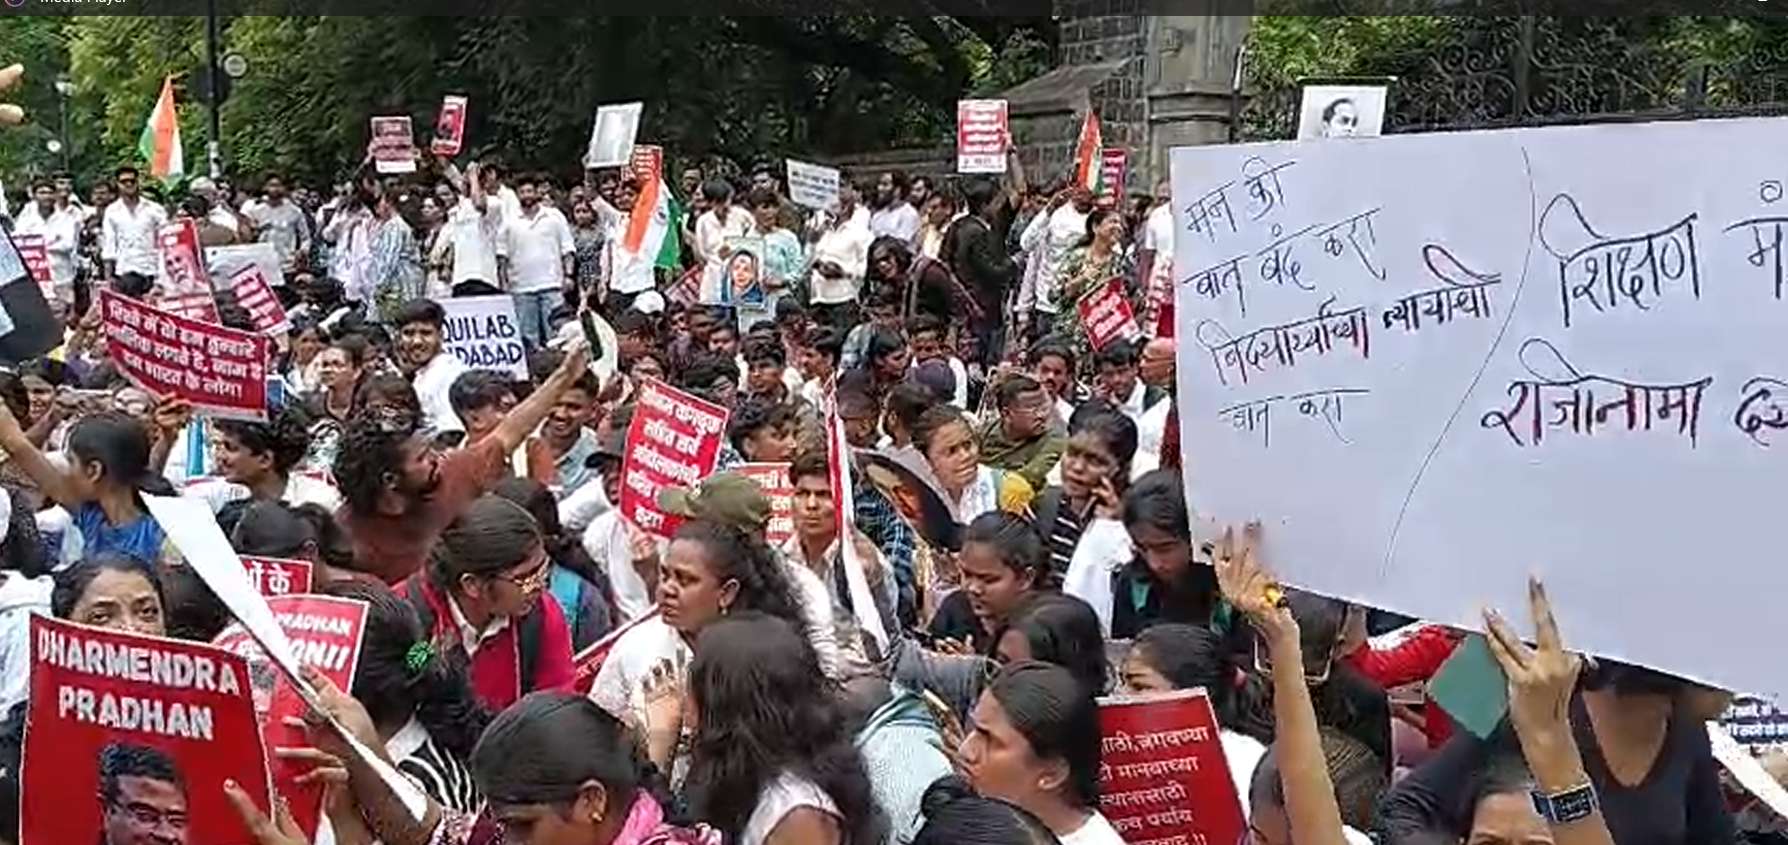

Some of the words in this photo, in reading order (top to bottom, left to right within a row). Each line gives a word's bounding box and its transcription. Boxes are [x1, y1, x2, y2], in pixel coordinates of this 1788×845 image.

[1538, 193, 1700, 328] शिक्षण
[267, 563, 293, 594] के
[37, 627, 241, 697] DHARMENDRA
[59, 686, 214, 741] PRADHAN
